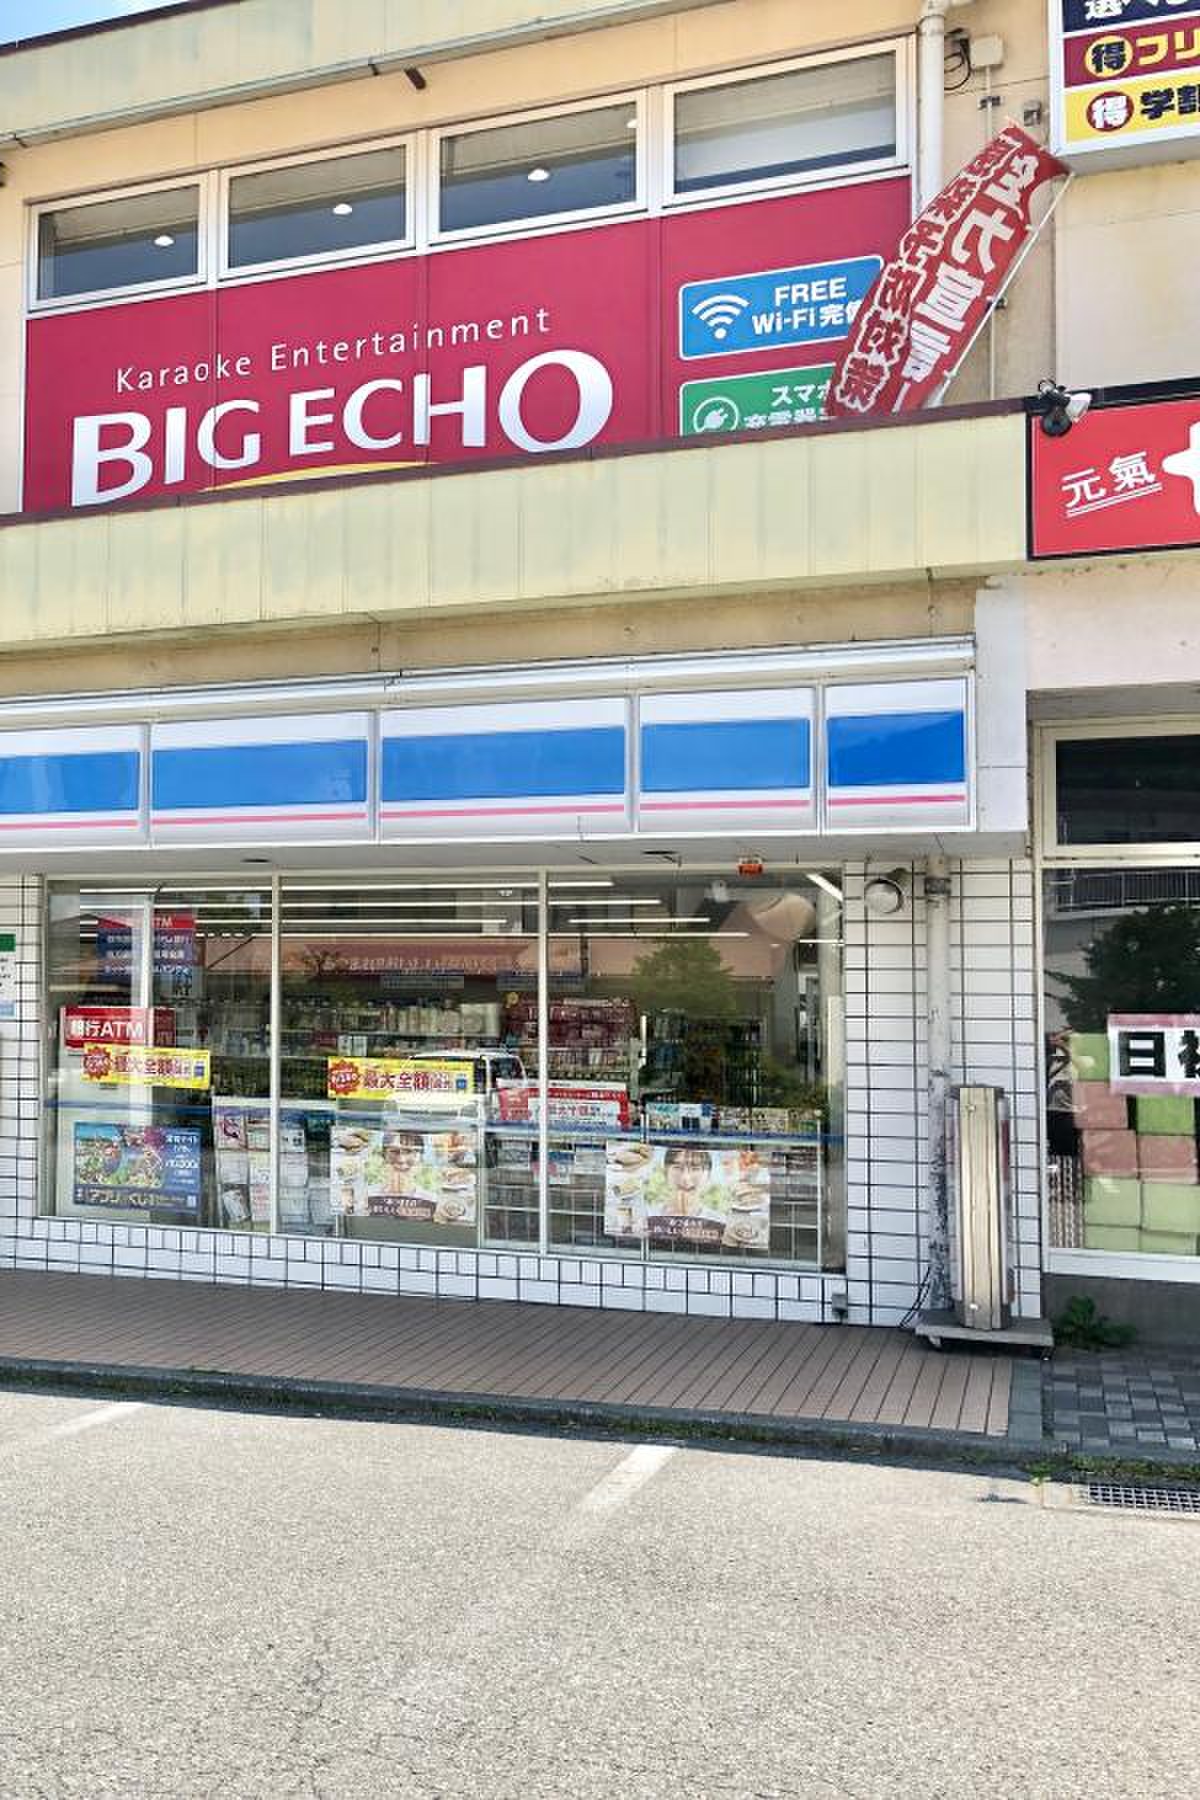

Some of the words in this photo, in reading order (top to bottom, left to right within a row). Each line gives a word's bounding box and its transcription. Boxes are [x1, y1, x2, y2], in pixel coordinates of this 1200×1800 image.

[774, 277, 848, 306] FREE
[117, 353, 251, 393] Karaoke
[271, 308, 550, 372] Entertainment
[71, 399, 261, 507] BIG
[289, 349, 613, 456] ECHO
